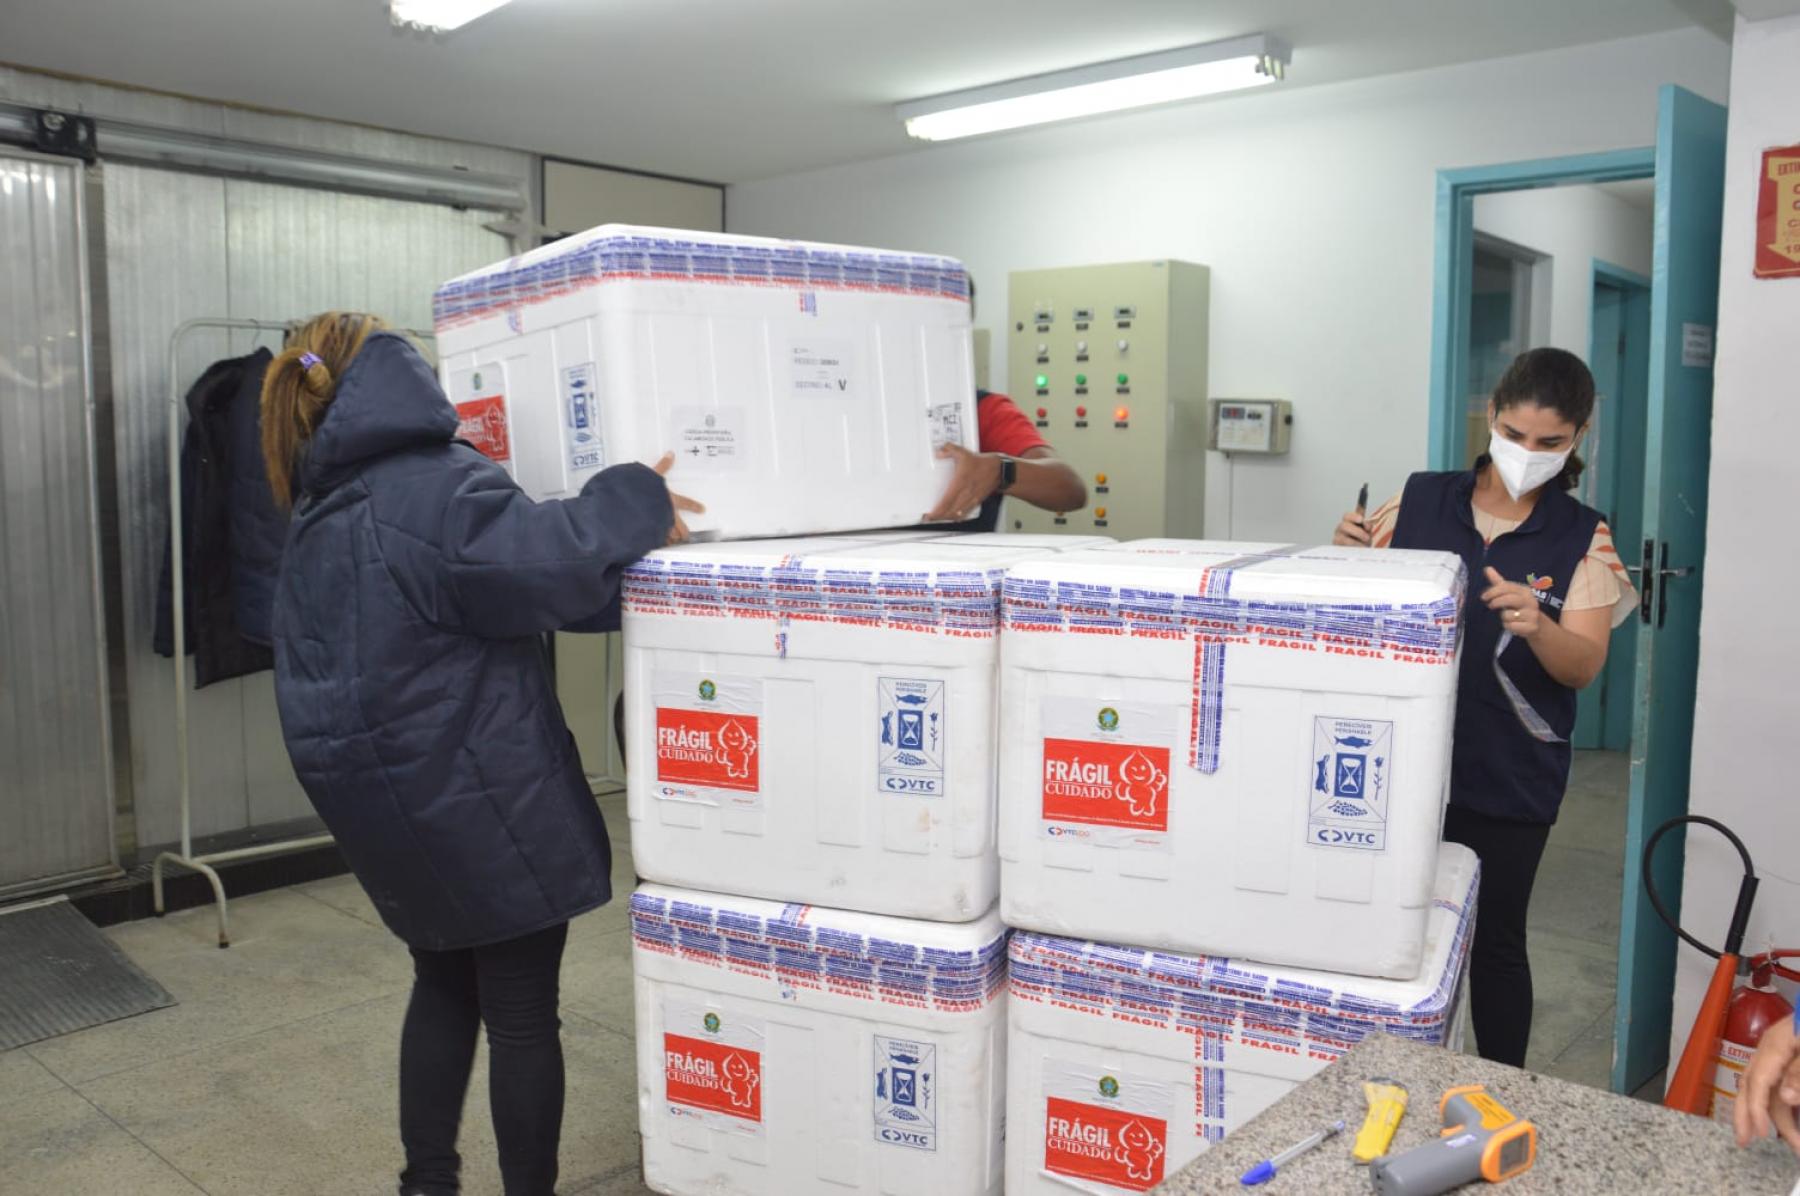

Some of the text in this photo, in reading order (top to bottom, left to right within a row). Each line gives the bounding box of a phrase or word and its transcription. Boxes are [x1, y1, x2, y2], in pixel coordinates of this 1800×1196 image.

[1056, 603, 1110, 617] FRAGIL
[1118, 610, 1174, 624] FRAGIL
[888, 622, 938, 635] FRAGIL
[944, 629, 993, 640] FRAGIL
[1258, 638, 1317, 652] FRAGIL
[1324, 645, 1385, 660] FRAGIL
[1392, 653, 1449, 666] FRAGIL
[658, 724, 713, 751] FRÁGIL
[658, 748, 714, 764] CUIDADO
[1045, 756, 1112, 786] FRÁGIL
[908, 779, 935, 790] VTC
[1045, 783, 1112, 800] CUIDADO
[1344, 831, 1376, 844] VTC
[1088, 959, 1140, 976] FRAGIL
[1148, 972, 1201, 989] FRAGIL
[1209, 985, 1265, 1001] FRAGIL
[1272, 998, 1330, 1016] FRAGIL
[880, 996, 929, 1010] FRAGIL
[1120, 1000, 1173, 1017] FRAGIL
[1050, 1000, 1104, 1016] FRAGIL
[1112, 1012, 1168, 1030] FRAGIL
[1175, 1025, 1233, 1043] FRAGIL
[1241, 1038, 1300, 1056] FRAGIL
[666, 1051, 718, 1079] FRÁGIL
[667, 1070, 719, 1090] CUIDADO
[902, 1133, 928, 1145] VTC
[1048, 1117, 1111, 1148] FRÁGIL
[1047, 1138, 1111, 1161] CUIDADO
